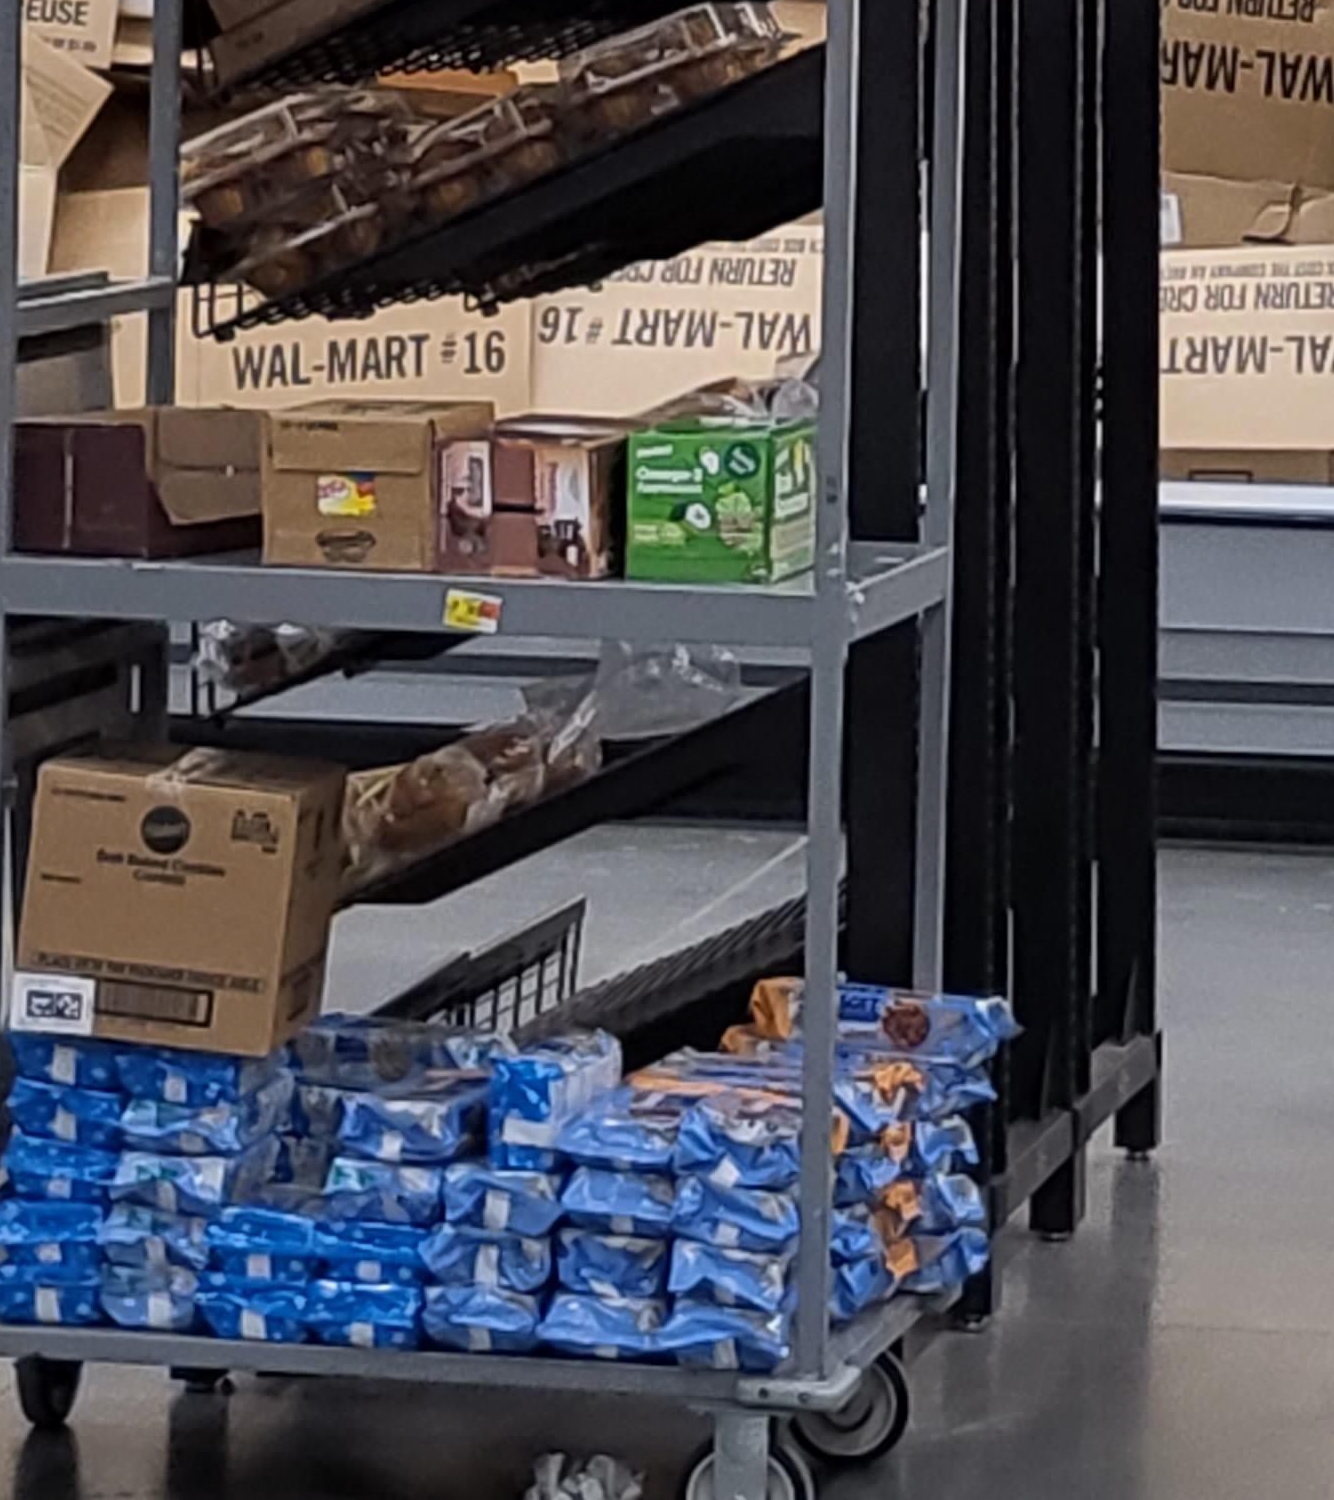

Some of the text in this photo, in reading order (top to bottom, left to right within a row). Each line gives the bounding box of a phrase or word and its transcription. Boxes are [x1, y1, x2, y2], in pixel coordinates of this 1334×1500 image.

[1162, 40, 1334, 105] WAL-MAR
[708, 255, 798, 287] RETURN
[1204, 283, 1247, 312] FOR
[538, 305, 812, 352] WAL-MART #16
[232, 329, 506, 391] WAL-MART #16
